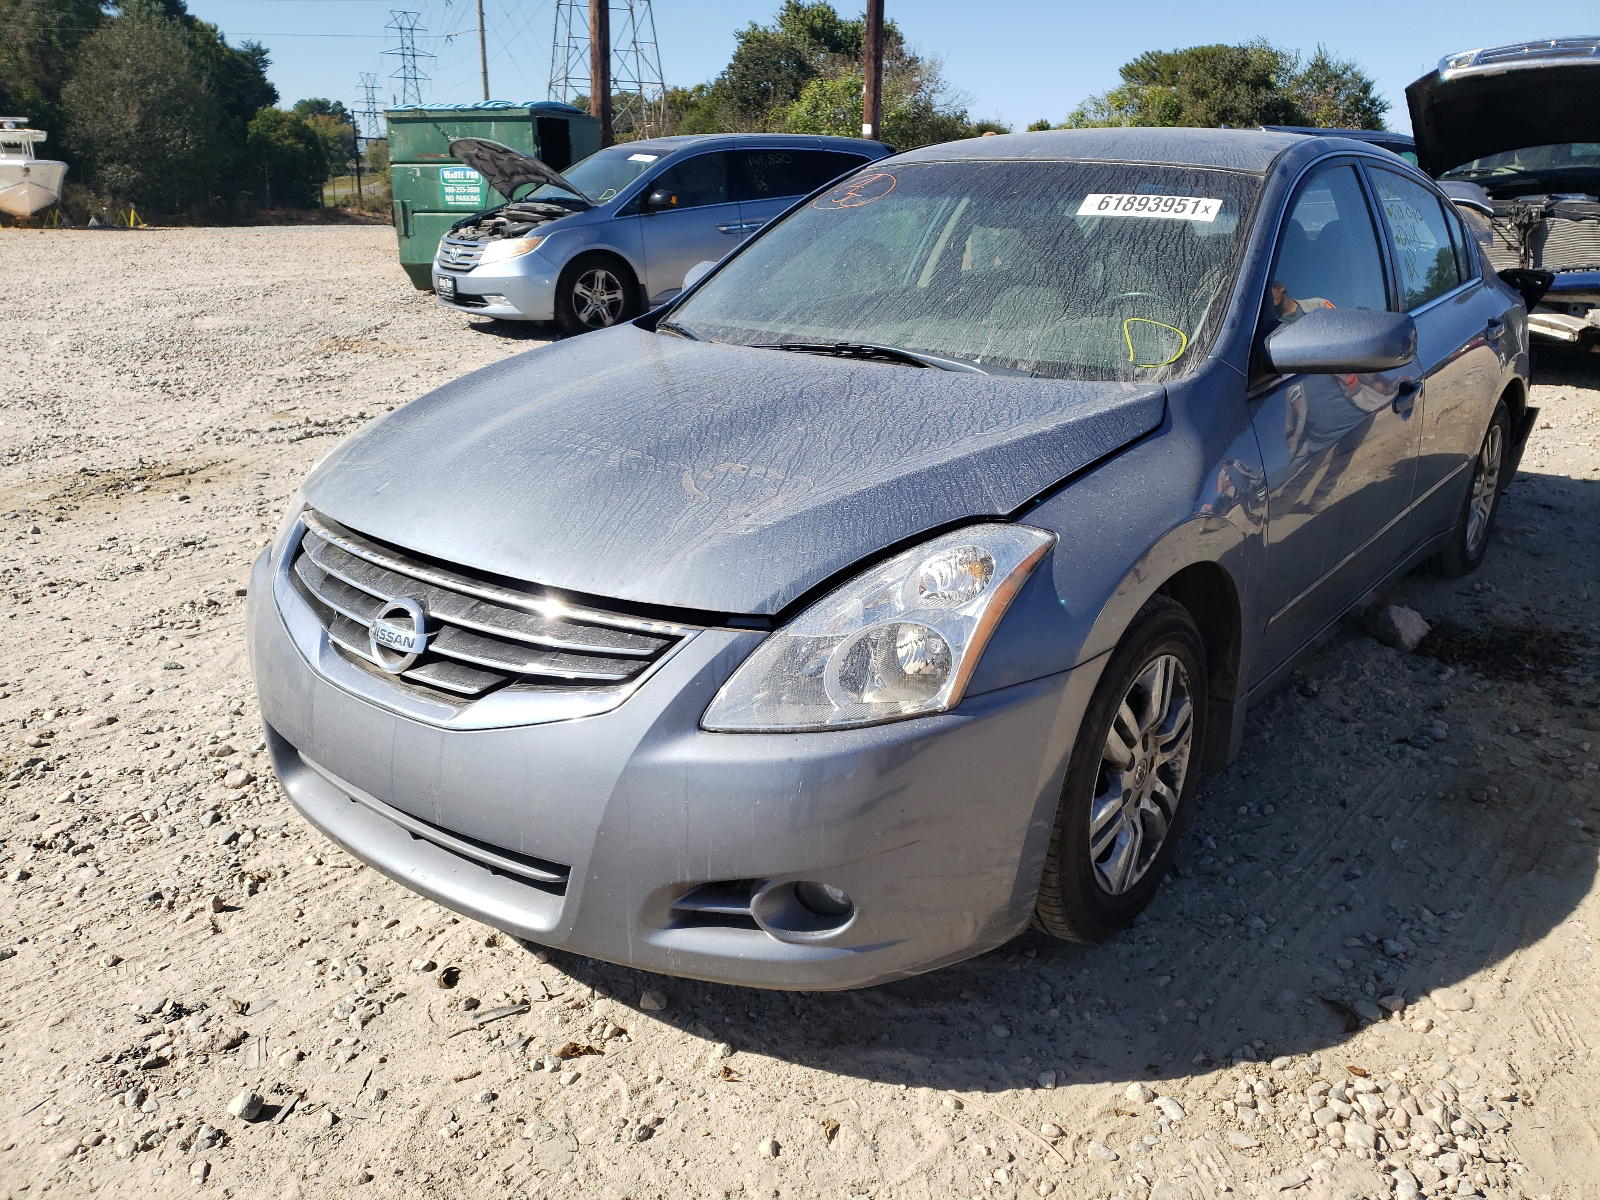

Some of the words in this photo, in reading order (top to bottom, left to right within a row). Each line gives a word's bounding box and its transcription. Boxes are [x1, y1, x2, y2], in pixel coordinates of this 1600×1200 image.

[443, 170, 465, 179] WASTE
[445, 194, 455, 202] NO
[456, 194, 481, 202] PARKING
